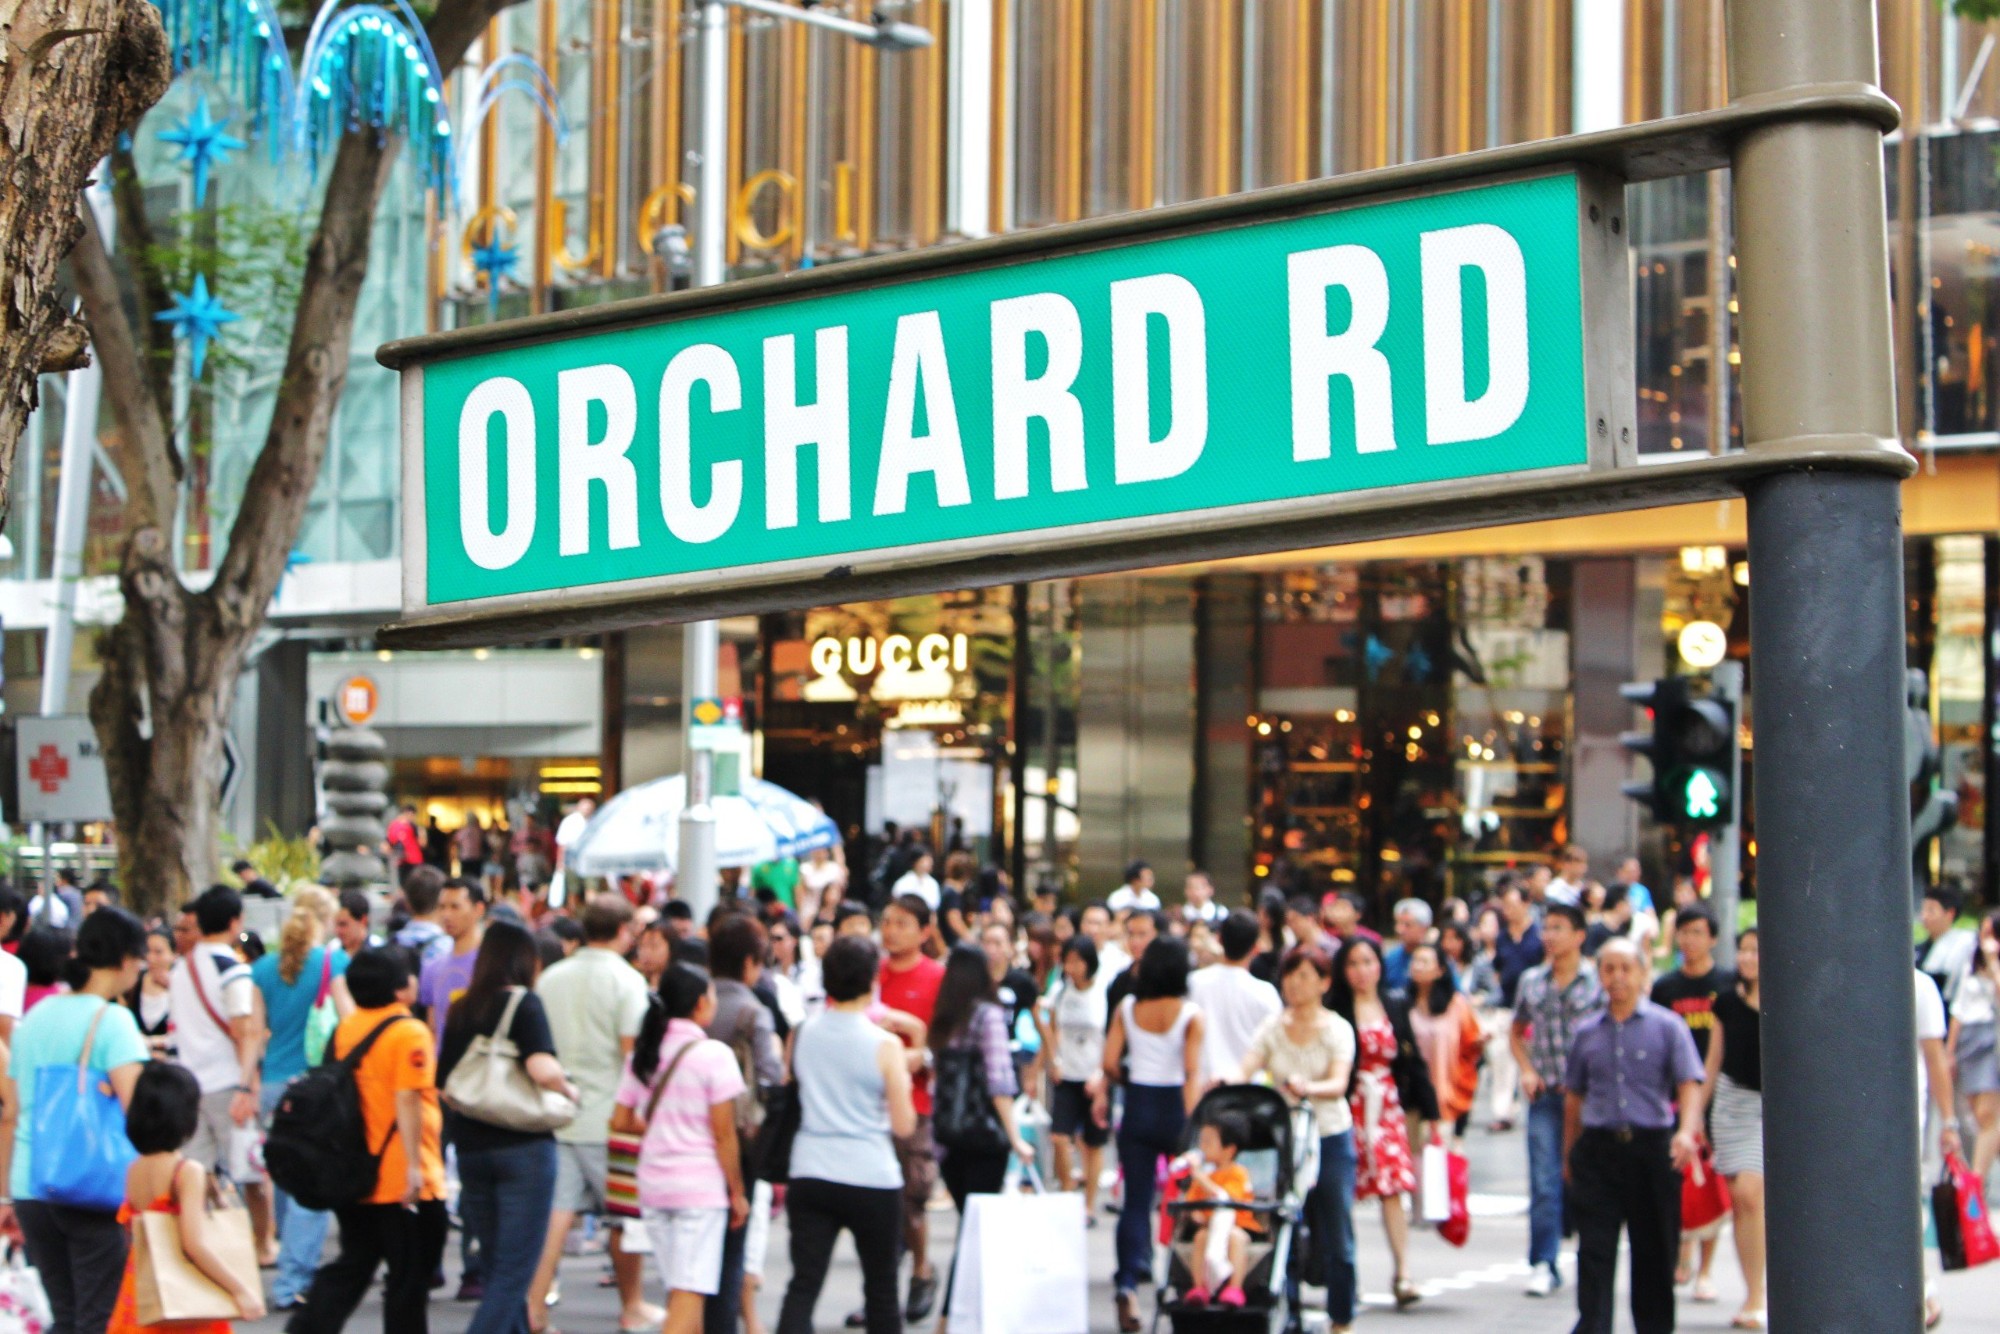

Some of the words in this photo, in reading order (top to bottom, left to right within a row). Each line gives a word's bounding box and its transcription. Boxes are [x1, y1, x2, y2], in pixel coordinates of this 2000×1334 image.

[458, 273, 1208, 571] ORCHARD
[1287, 223, 1530, 462] RD
[811, 633, 968, 676] GUCCI
